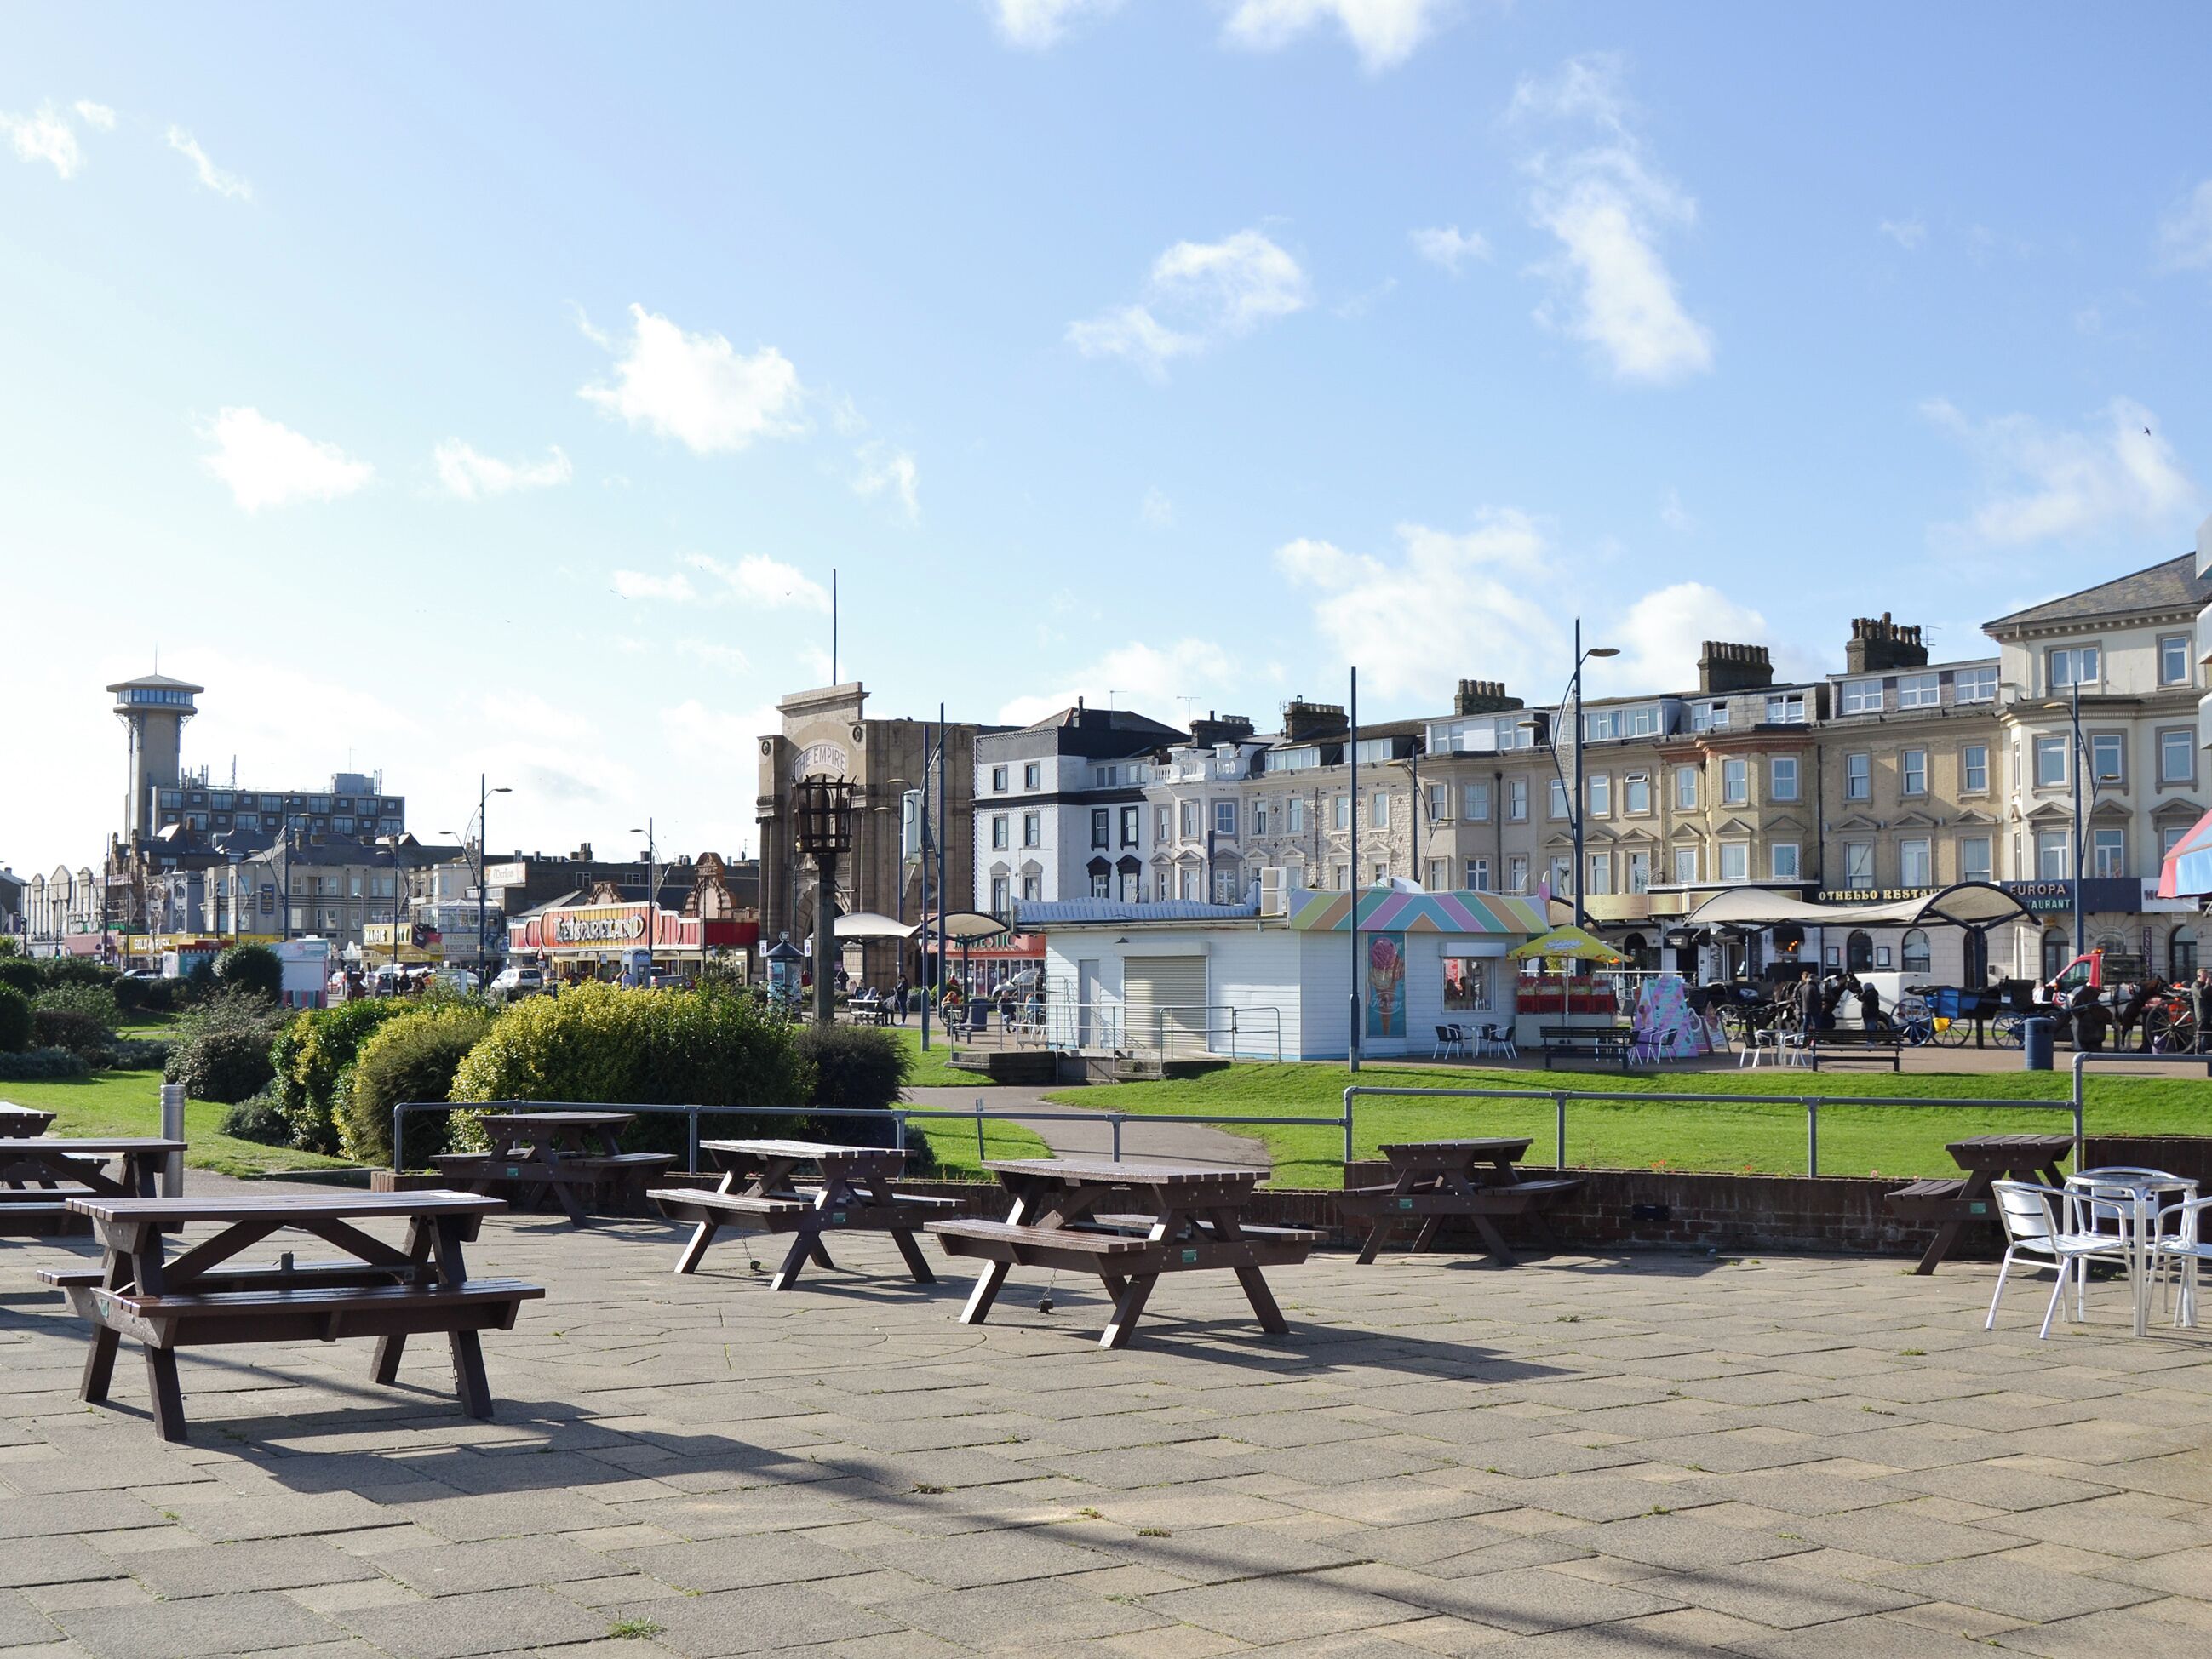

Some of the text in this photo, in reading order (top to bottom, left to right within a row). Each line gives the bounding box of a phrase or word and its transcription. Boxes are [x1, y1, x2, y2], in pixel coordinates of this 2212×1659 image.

[795, 747, 845, 778] THE EMPIRE
[2009, 884, 2066, 895] EUROPA
[1818, 890, 1878, 901] OTHELLO
[364, 928, 387, 943] MAGIC
[134, 939, 149, 950] GOLD
